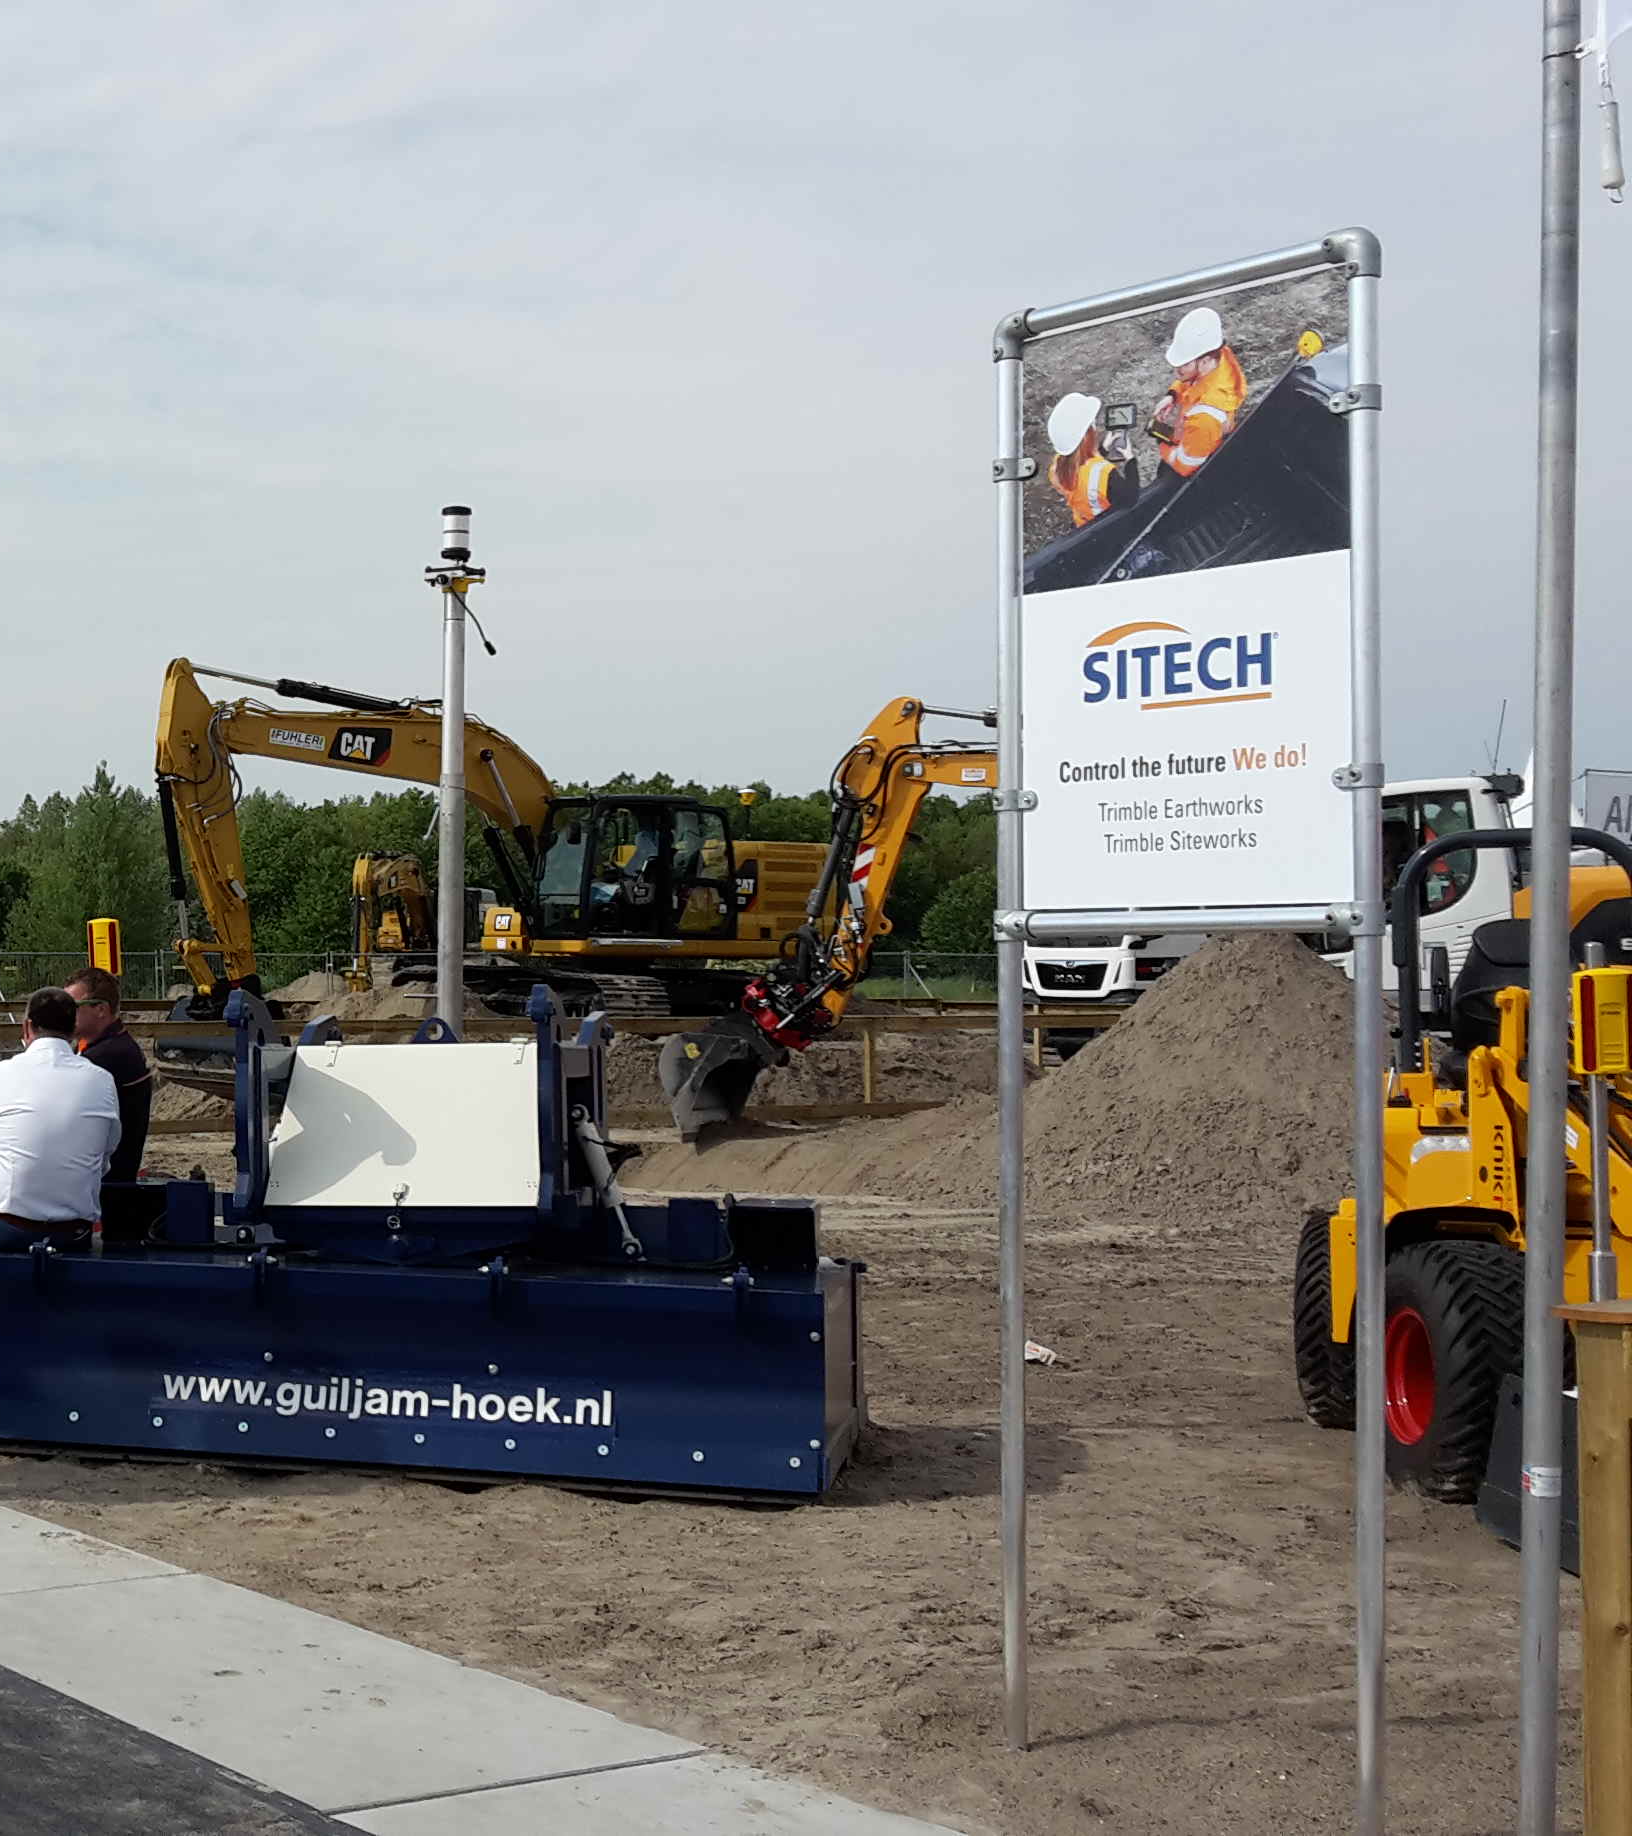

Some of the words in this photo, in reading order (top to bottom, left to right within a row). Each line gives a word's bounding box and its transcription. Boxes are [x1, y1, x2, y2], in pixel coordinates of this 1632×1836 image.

[1083, 632, 1272, 703] SITECH
[340, 732, 375, 760] CAT
[1059, 757, 1126, 784] Control
[1131, 755, 1162, 778] the
[1168, 752, 1226, 776] future
[1232, 747, 1267, 771] We
[1274, 743, 1307, 768] do!
[1098, 800, 1158, 822] Trimble
[1164, 795, 1264, 819] Earthworks
[1104, 832, 1164, 854] Trimble
[1170, 828, 1257, 851] Siteworks
[163, 1371, 613, 1426] www.guiljam-hoek.nl
